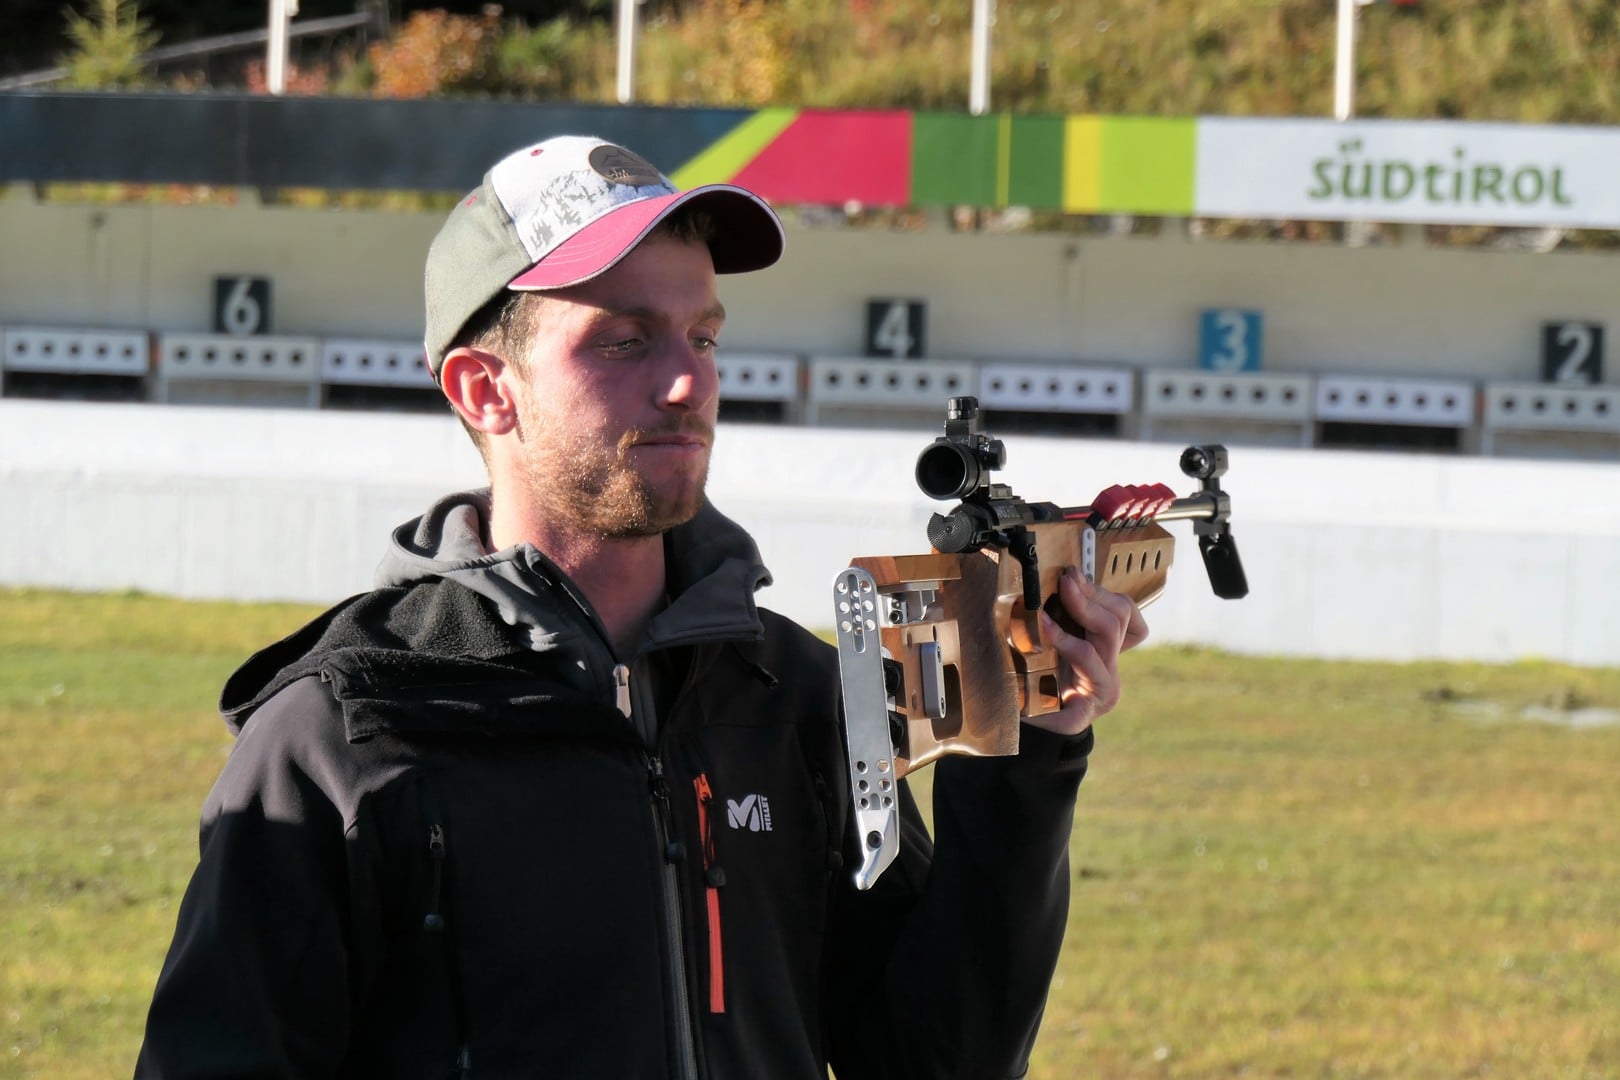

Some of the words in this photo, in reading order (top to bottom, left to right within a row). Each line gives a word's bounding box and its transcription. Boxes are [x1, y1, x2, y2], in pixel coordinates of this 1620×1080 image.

[222, 277, 260, 337] 6
[875, 300, 914, 361] 4
[1211, 310, 1248, 375] 3
[1556, 323, 1593, 388] 2
[761, 795, 773, 831] MILLET
